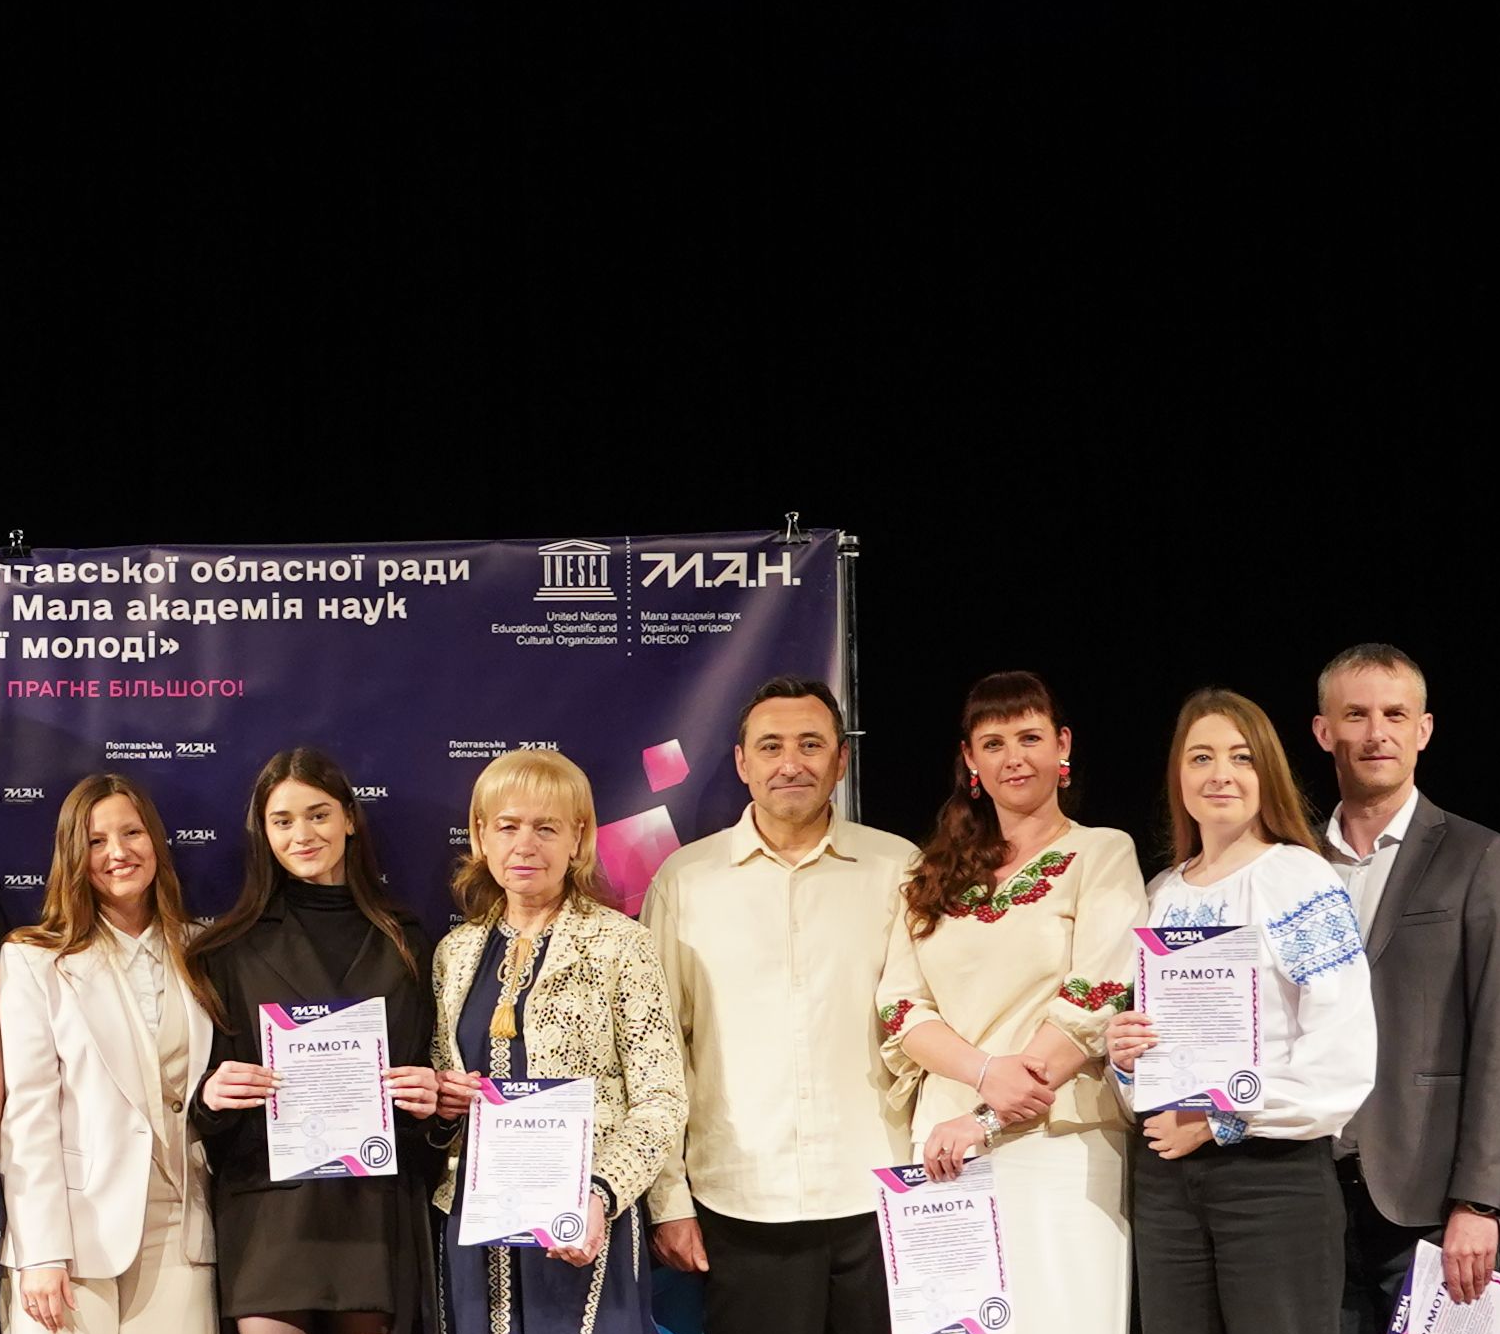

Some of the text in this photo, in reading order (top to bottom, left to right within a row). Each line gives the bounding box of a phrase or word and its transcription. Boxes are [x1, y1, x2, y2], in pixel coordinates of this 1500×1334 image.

[191, 554, 366, 583] обласної
[378, 558, 470, 587] ради
[544, 555, 609, 586] UNESCO
[12, 594, 114, 621] Мала
[126, 592, 304, 625] академія
[318, 591, 408, 626] наук
[546, 611, 618, 621] United Nations
[491, 623, 618, 634] Educational, Scientific and
[516, 634, 618, 647] Cultural Organization
[641, 634, 690, 645] ЮНЕСКО
[22, 631, 180, 663] молоді»
[8, 680, 100, 698] ПРАГНЕ
[109, 679, 244, 698] БІЛЬШОГО!
[1161, 968, 1236, 980] ГРАМОТА
[289, 1040, 361, 1054] ГРАМОТА
[495, 1118, 567, 1129] ГРАМОТА
[903, 1199, 975, 1217] ГРАМОТА
